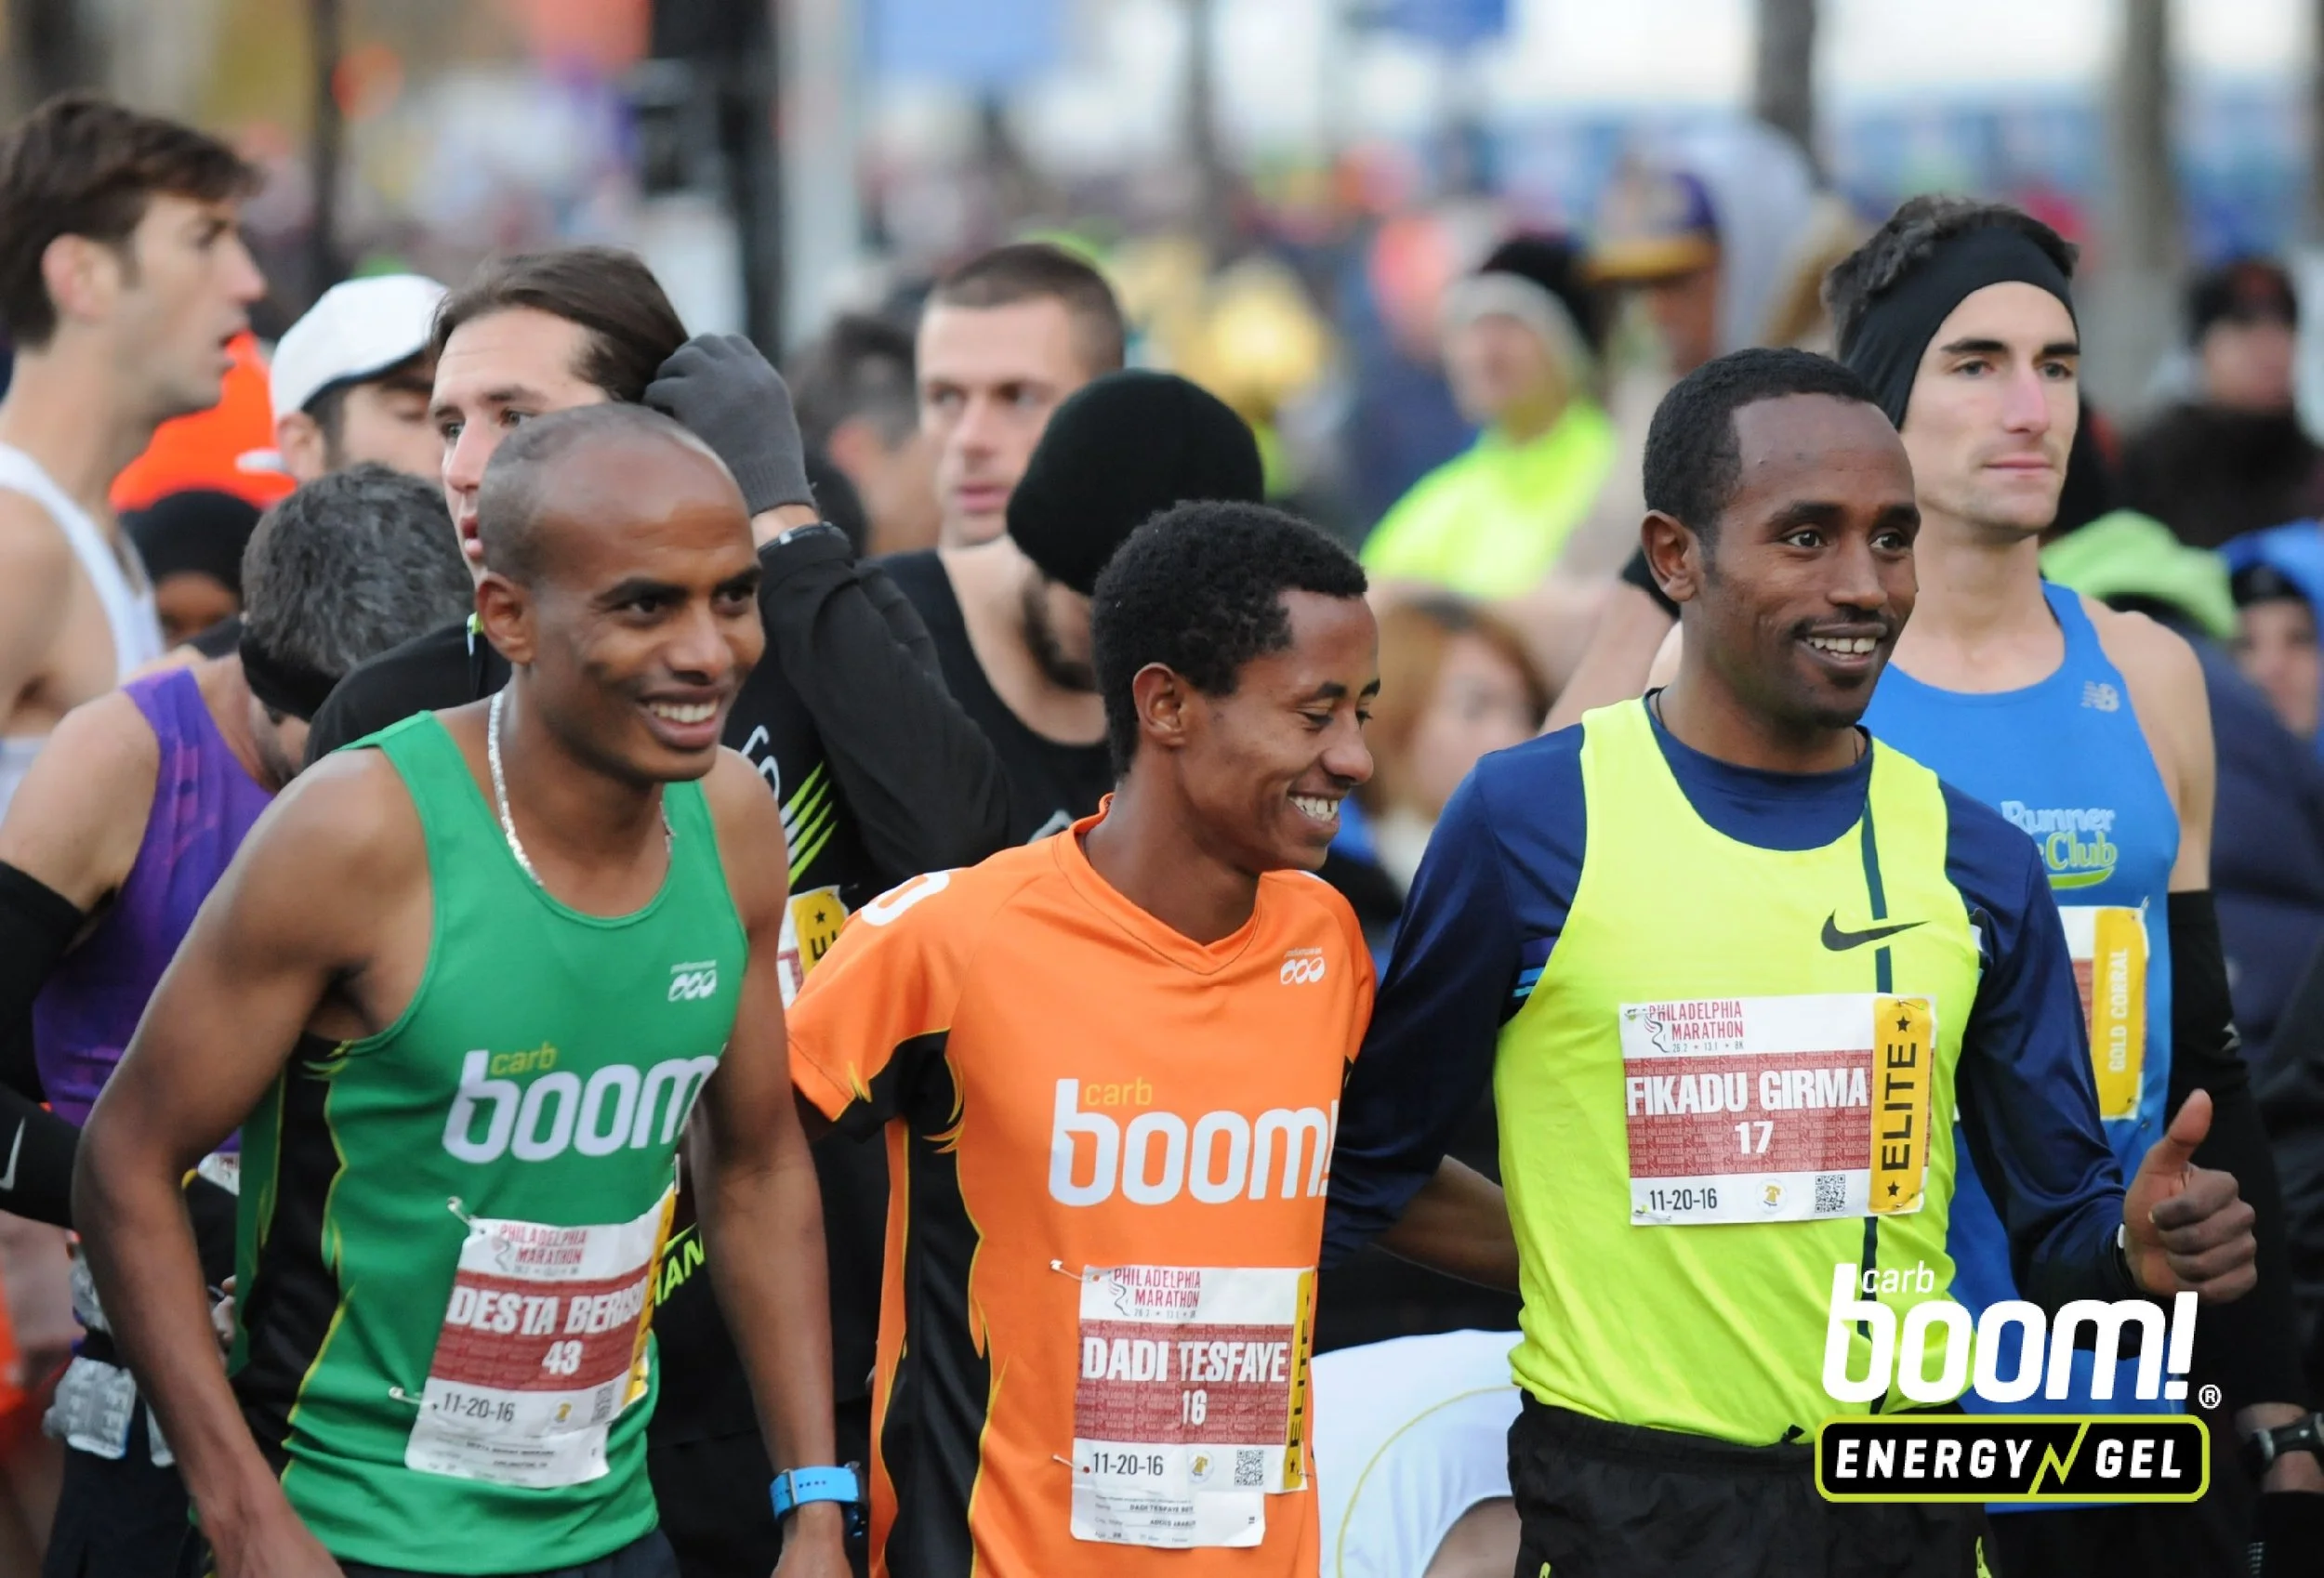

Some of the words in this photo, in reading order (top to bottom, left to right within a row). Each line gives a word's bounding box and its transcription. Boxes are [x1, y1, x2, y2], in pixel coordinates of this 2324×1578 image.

[2000, 800, 2116, 835] Runner
[2108, 948, 2128, 1019] CORRAL
[1649, 1001, 1742, 1021] PHILADELPHIA
[1671, 1021, 1744, 1042] MARATHON
[2108, 1024, 2127, 1072] GOLD
[490, 1041, 559, 1076] carb
[1085, 1076, 1153, 1106] carb
[1626, 1072, 1749, 1116] FIKADU
[1759, 1067, 1868, 1111] GIRMA
[1882, 1042, 1917, 1170] ELITE
[1048, 1078, 1339, 1206] boom!
[1735, 1121, 1775, 1154] 17
[1649, 1188, 1718, 1211] 11-20-16
[499, 1223, 589, 1246] PHILADELPHIA
[515, 1246, 584, 1266] MARATHON
[1114, 1268, 1201, 1289] PHILADELPHIA
[445, 1285, 561, 1335] DESTA
[1134, 1289, 1200, 1308] MARATHON
[541, 1339, 585, 1374] 43
[1081, 1335, 1170, 1382] DADI
[1178, 1340, 1287, 1383] TESFAYE
[442, 1392, 516, 1423] 11-20-16
[1182, 1388, 1208, 1426] 16
[1092, 1452, 1164, 1476] 11-20-16
